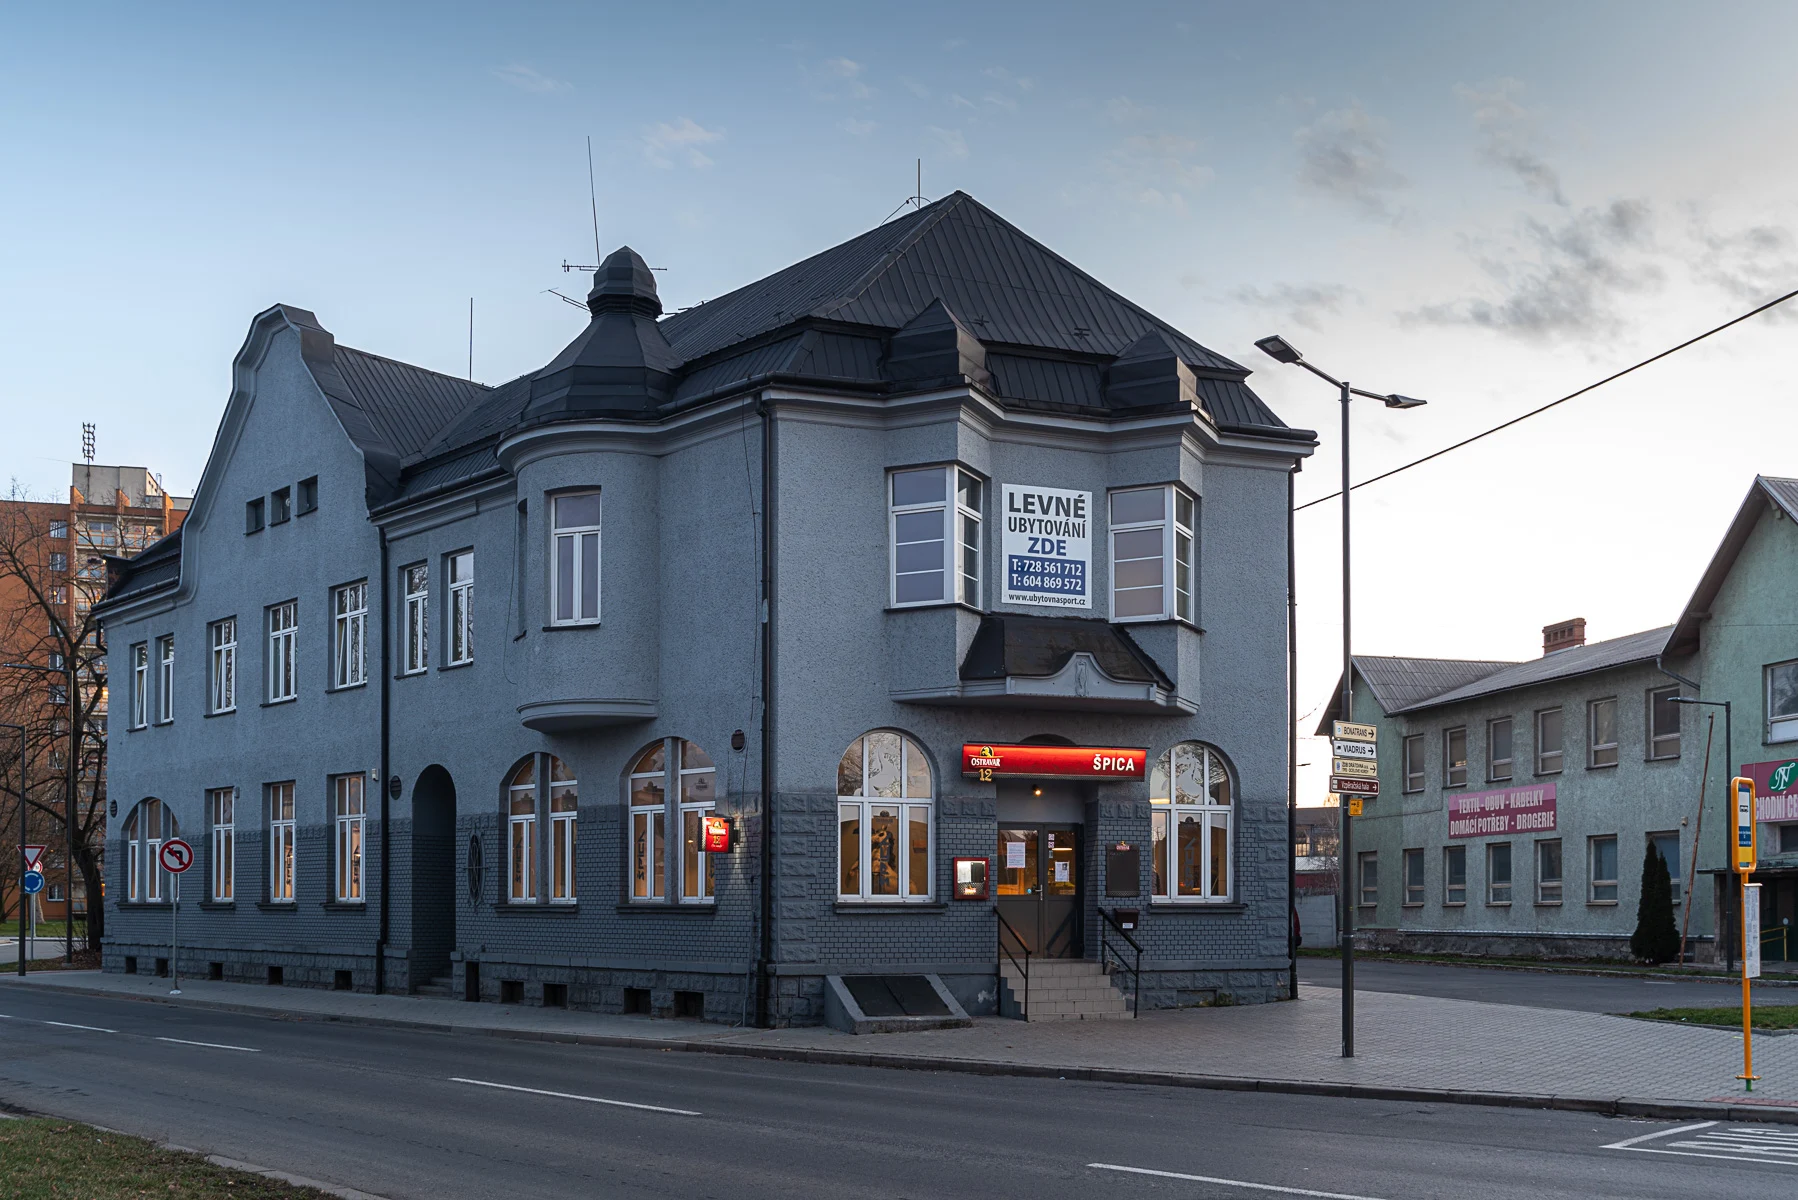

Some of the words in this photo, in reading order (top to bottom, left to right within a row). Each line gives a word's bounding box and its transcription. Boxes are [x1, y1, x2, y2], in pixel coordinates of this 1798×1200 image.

[1009, 492, 1085, 519] LEVNÉ
[1009, 516, 1086, 538] UBYTOVÁNÍ
[1028, 537, 1066, 556] ZDE
[1012, 559, 1021, 571] T:
[1023, 560, 1042, 572] 728
[1044, 562, 1061, 574] 561
[1064, 564, 1082, 576] 712
[1012, 574, 1021, 586] T:
[1023, 575, 1042, 587] 604
[1044, 577, 1062, 589] 869
[1064, 579, 1082, 591] 572
[1009, 593, 1086, 606] www.ubytovnasport.cz
[1344, 726, 1367, 737] BONATRANS
[1343, 744, 1366, 755] VIADRUS
[971, 757, 1001, 767] OSTRAVAR
[1093, 753, 1135, 771] ŠPICA
[979, 768, 993, 782] 12
[1459, 797, 1480, 814] TEXTIL
[1485, 794, 1505, 811] OBUV
[1510, 789, 1544, 808] KABELKY
[1755, 791, 1787, 820] CHODNÍ
[1450, 815, 1478, 835] DOMÁCÍ
[1478, 813, 1509, 833] POTŘEBY
[1516, 811, 1555, 830] DROGERIE
